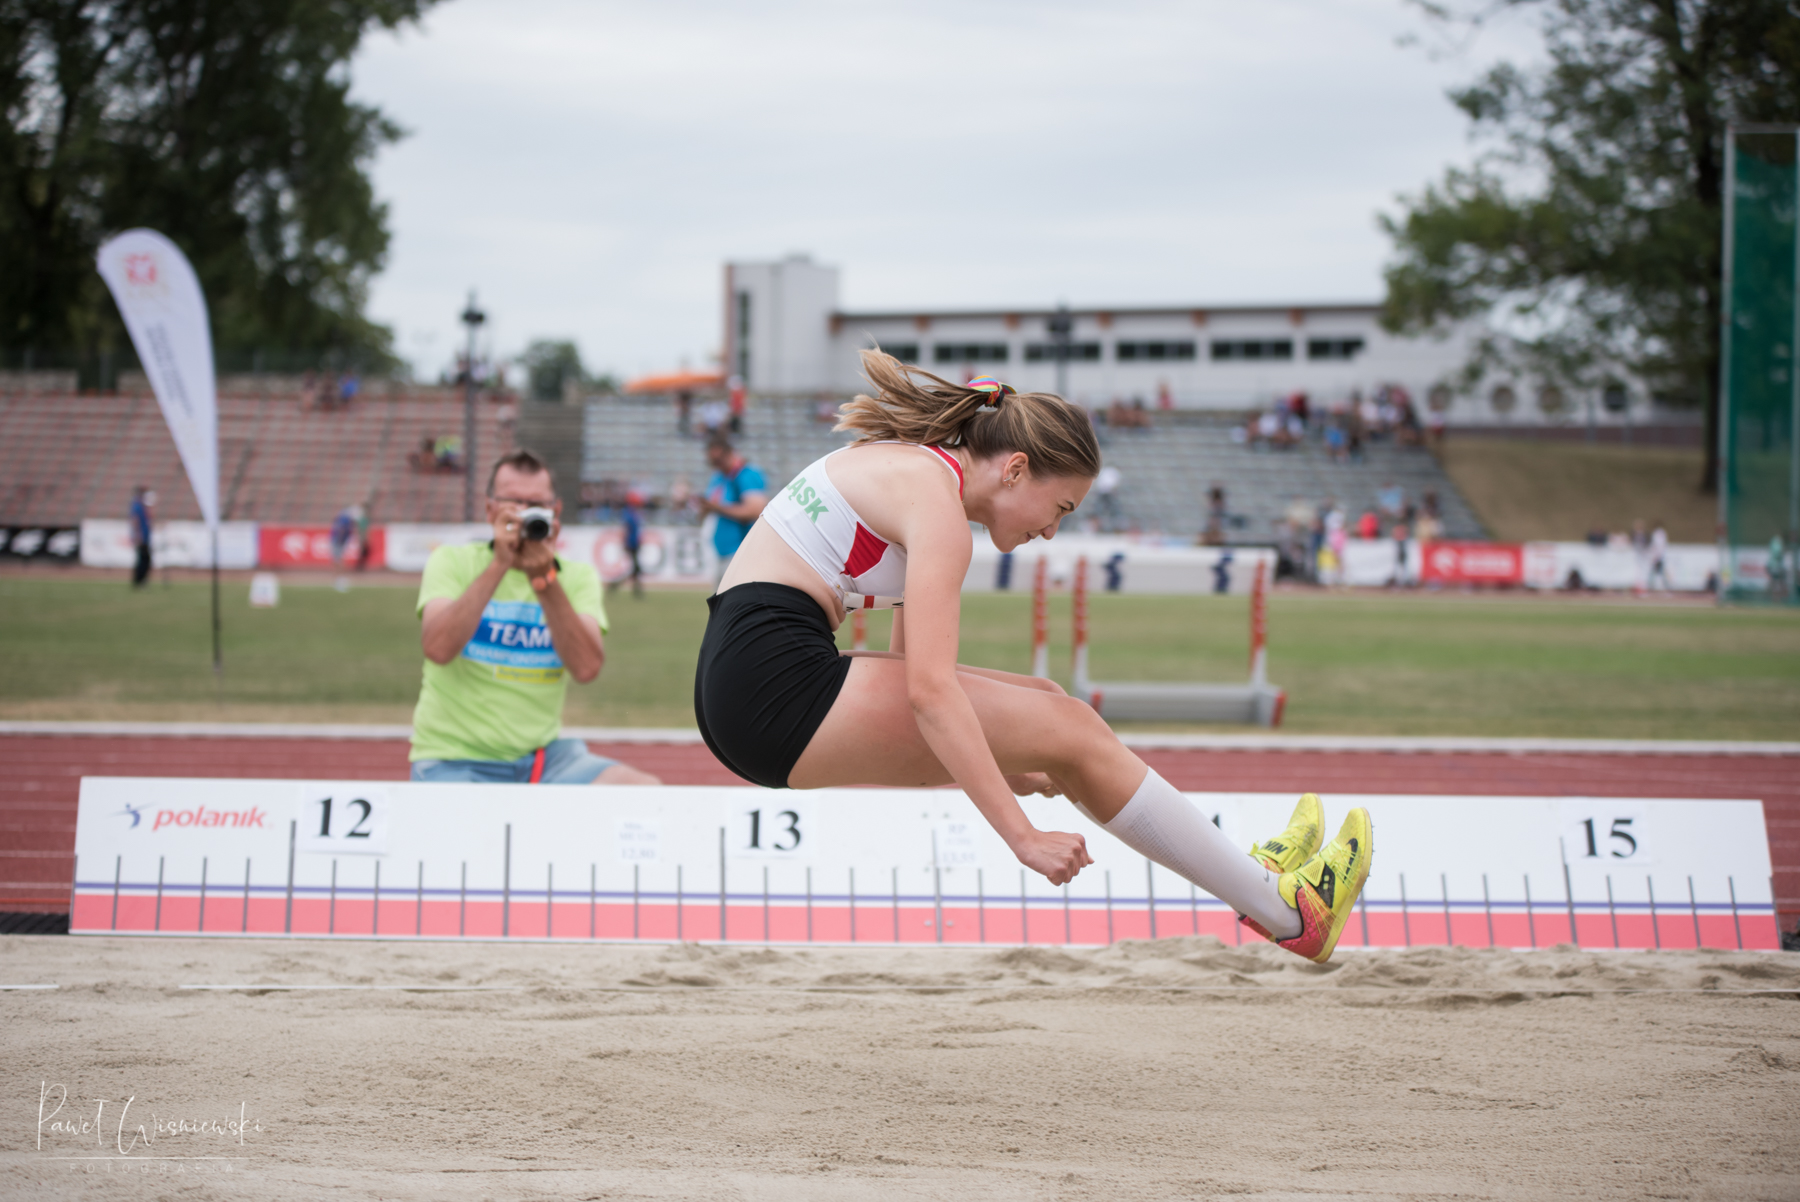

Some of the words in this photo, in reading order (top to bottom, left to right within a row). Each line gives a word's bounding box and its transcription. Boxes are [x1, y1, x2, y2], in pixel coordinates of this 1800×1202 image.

[786, 477, 829, 523] ĄSK
[489, 623, 551, 648] TEAM
[152, 805, 266, 831] polanik
[316, 797, 373, 838] 12
[744, 809, 803, 852] 13
[1582, 816, 1638, 859] 15
